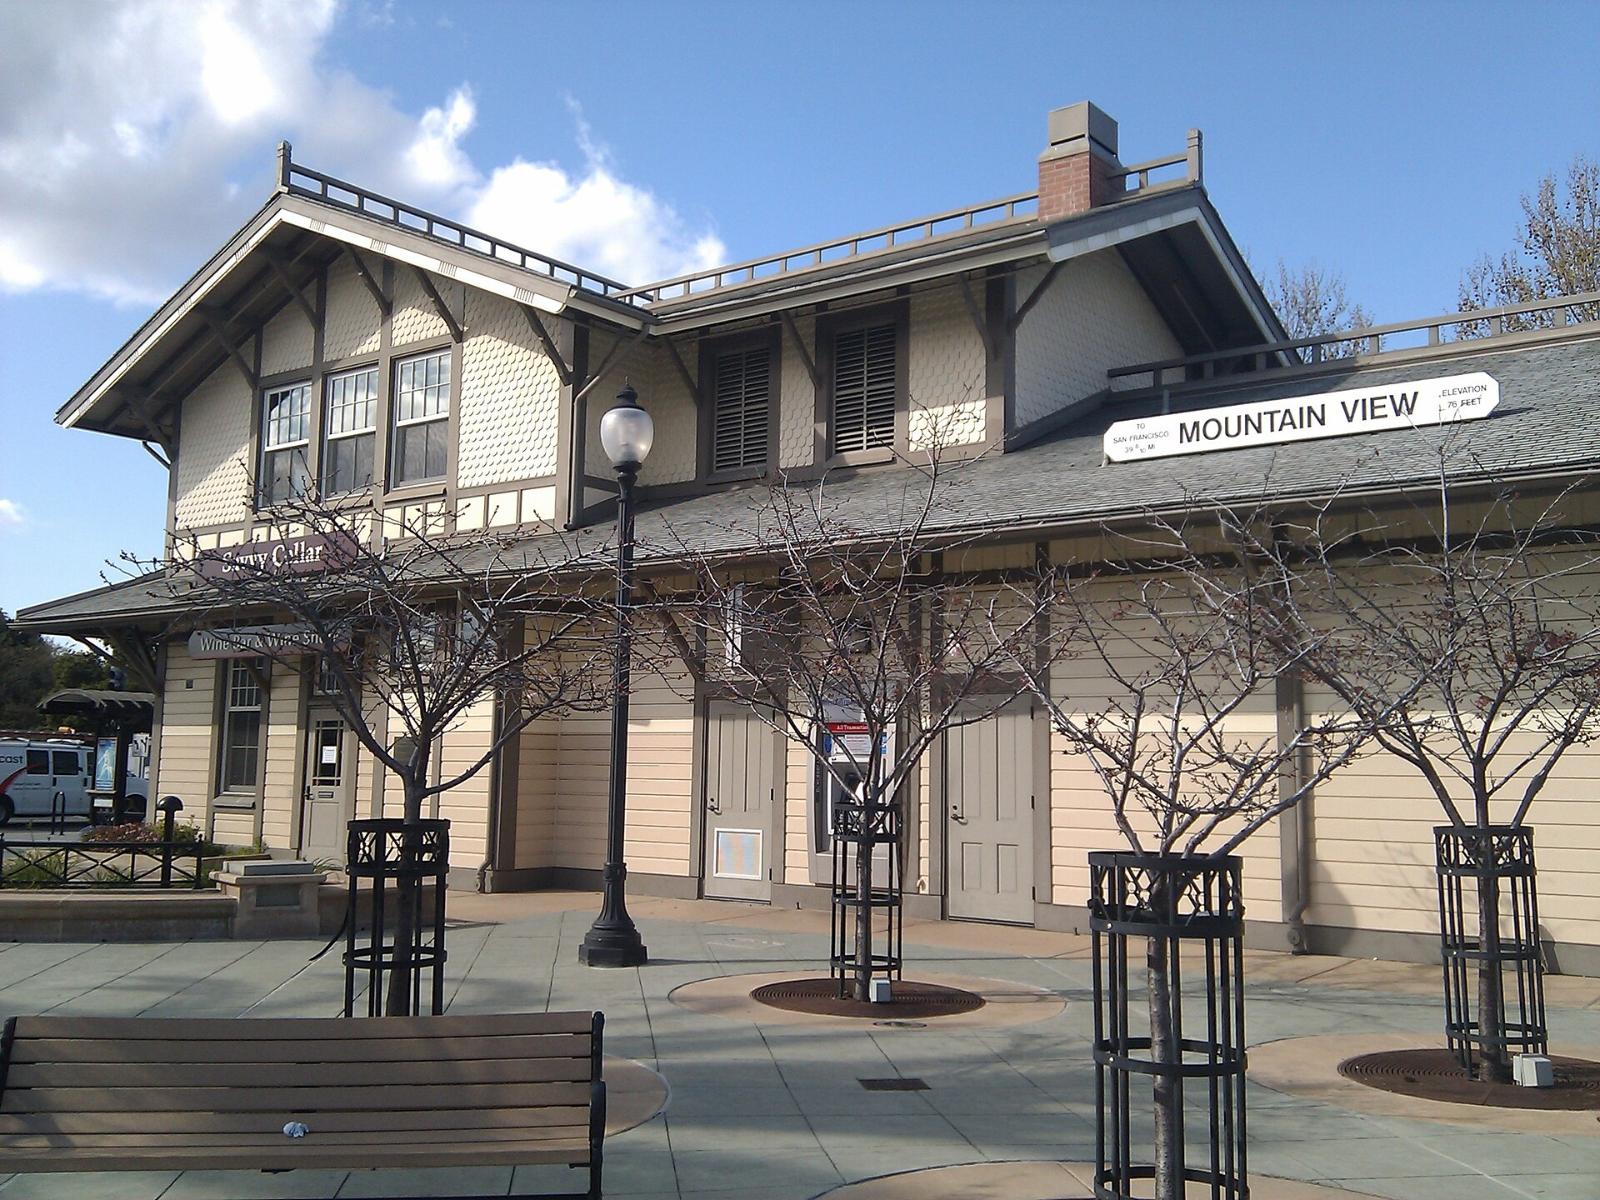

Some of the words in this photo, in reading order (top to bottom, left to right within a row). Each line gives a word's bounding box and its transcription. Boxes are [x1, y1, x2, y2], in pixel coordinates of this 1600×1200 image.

[1442, 385, 1487, 396] ELEVATION
[1460, 397, 1482, 406] FEET
[1179, 403, 1325, 444] MOUNTAIN
[1341, 391, 1419, 423] VIEW
[1129, 431, 1169, 441] FRANCISCO
[200, 637, 230, 651] Wine
[254, 635, 264, 648] &
